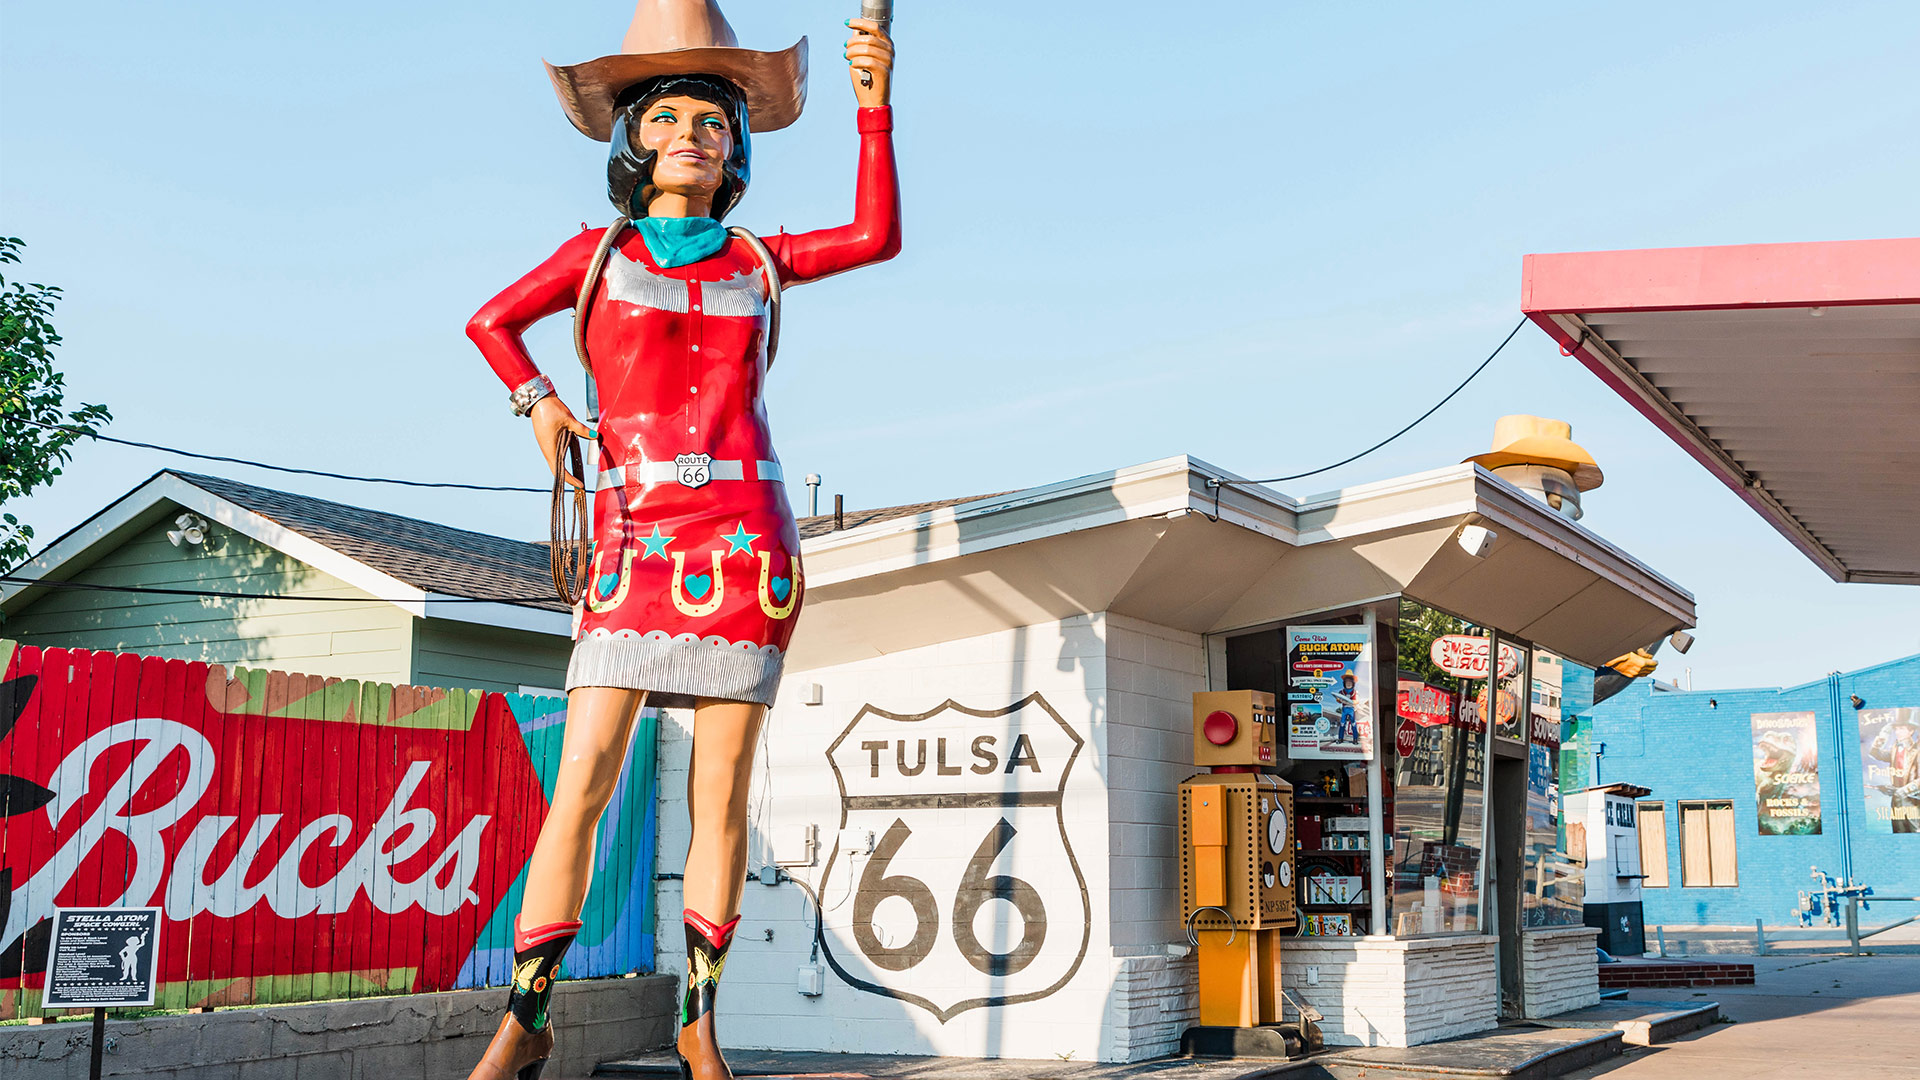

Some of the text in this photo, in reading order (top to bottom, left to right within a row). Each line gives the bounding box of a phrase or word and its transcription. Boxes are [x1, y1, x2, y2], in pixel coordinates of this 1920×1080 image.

[683, 467, 705, 483] 66
[1294, 634, 1328, 642] Come Visit
[1299, 643, 1364, 652] BUCK ATOM!
[1409, 687, 1448, 717] ROUTE 66
[1459, 699, 1481, 726] GIFTS
[861, 734, 1042, 778] TULSA
[1773, 773, 1816, 786] SCIENCE
[1766, 798, 1809, 808] ROCKS &
[1770, 808, 1809, 818] FOSSILS
[0, 718, 491, 953] Bucks
[853, 817, 1047, 977] 66
[1265, 902, 1274, 913] NP
[66, 914, 149, 922] STELLA ATOM
[1337, 920, 1348, 935] 66
